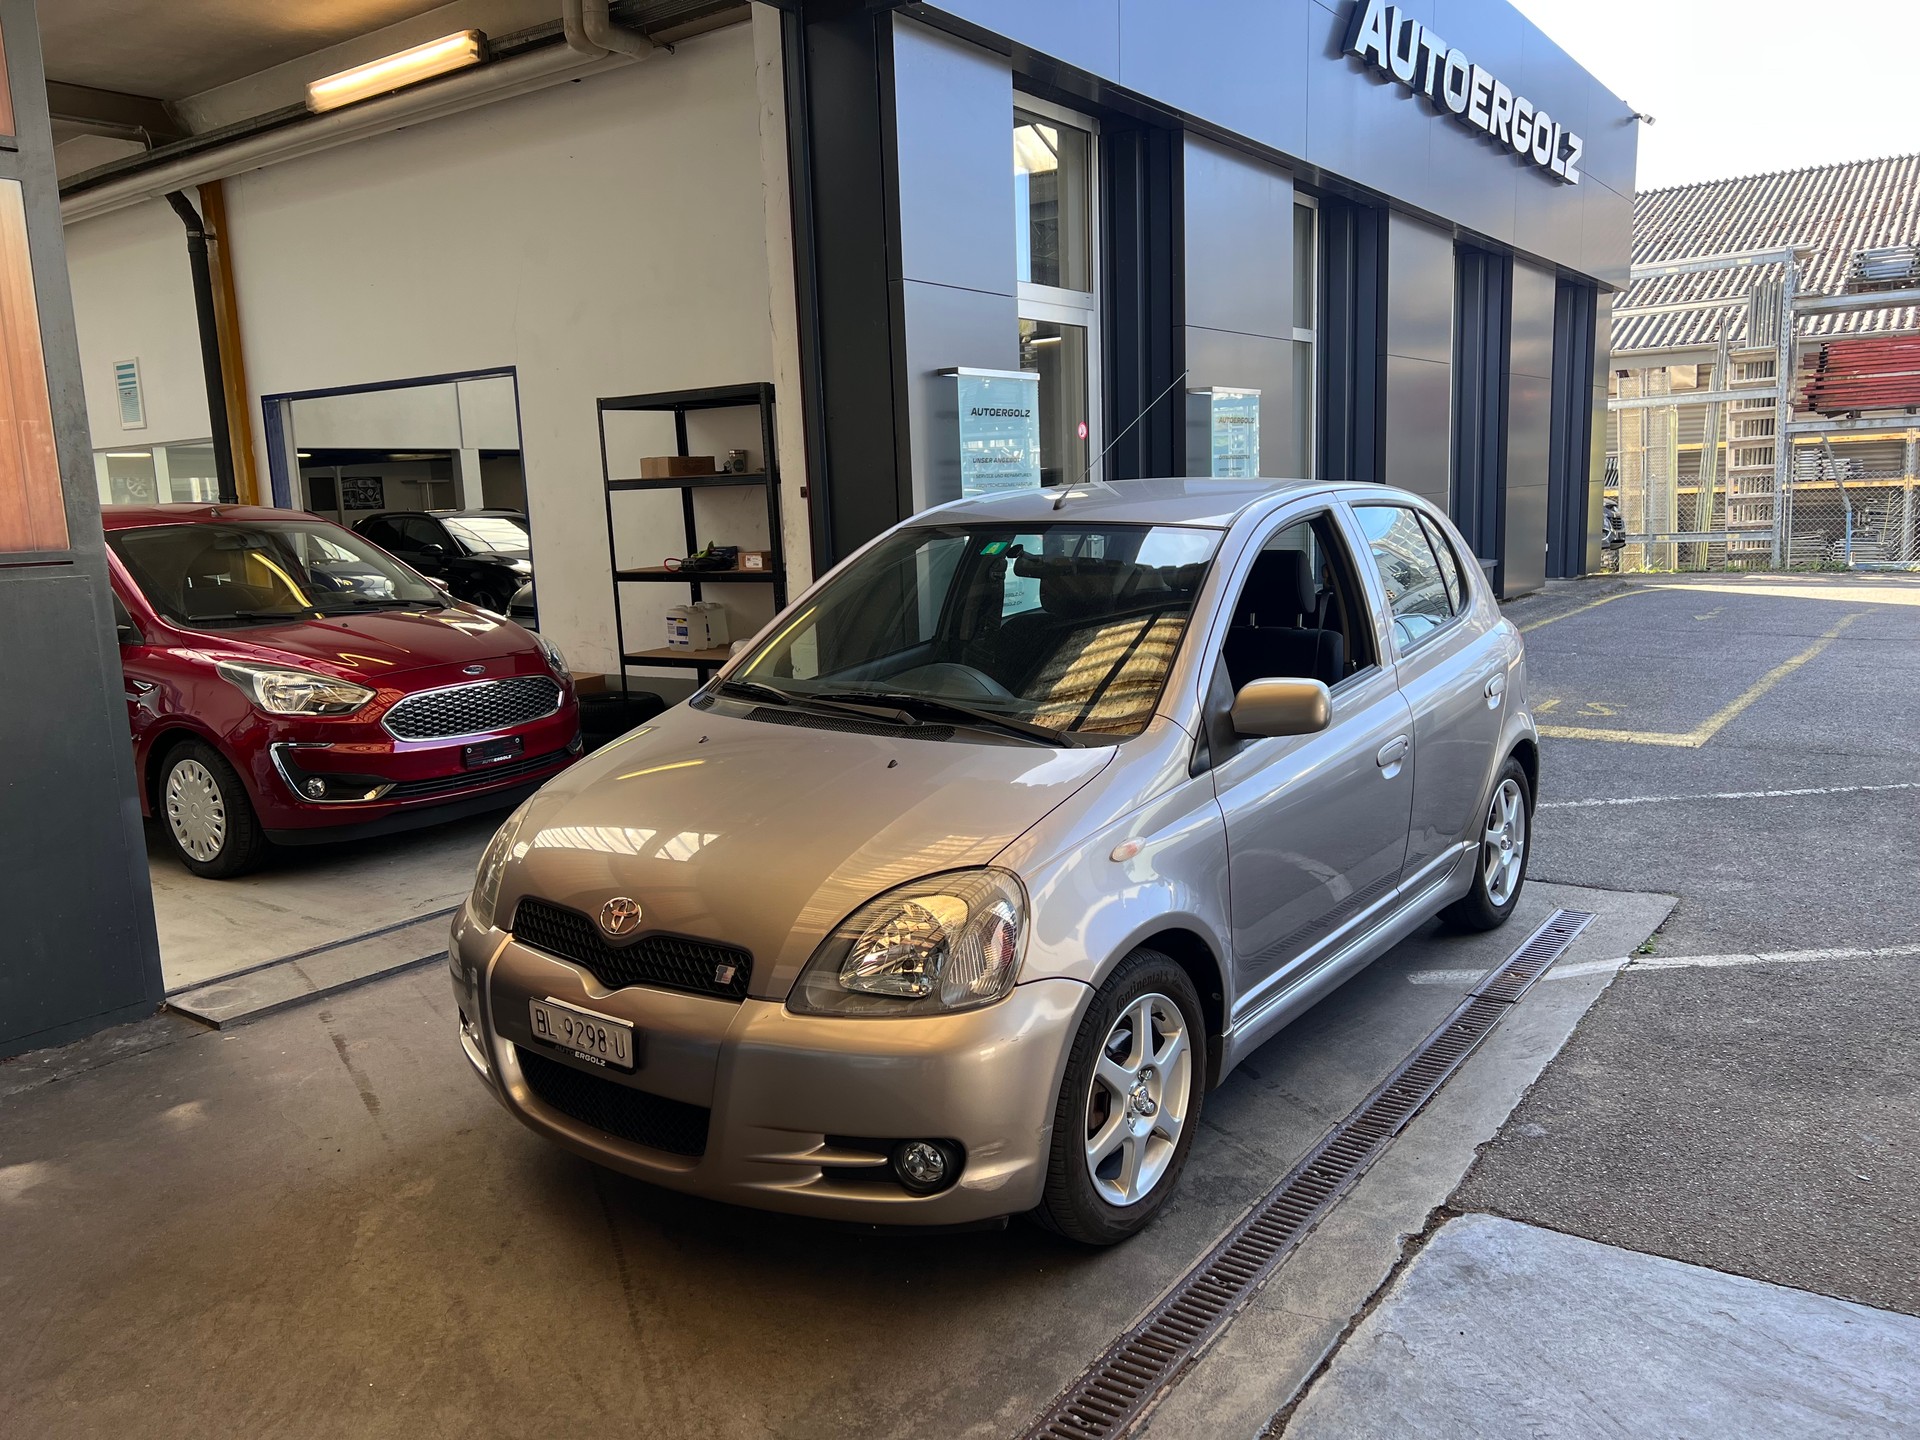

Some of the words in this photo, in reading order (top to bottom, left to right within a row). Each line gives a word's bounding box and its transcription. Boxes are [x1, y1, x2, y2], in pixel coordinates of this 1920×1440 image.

[1354, 0, 1583, 185] AUTOERGOLZ
[971, 408, 1030, 417] AUTOERGOLZ
[1116, 970, 1164, 1013] Continental
[535, 1007, 558, 1039] BL
[563, 1016, 608, 1054] 9298
[614, 1031, 627, 1060] U
[554, 1044, 606, 1067] AUTOERGOLZ
